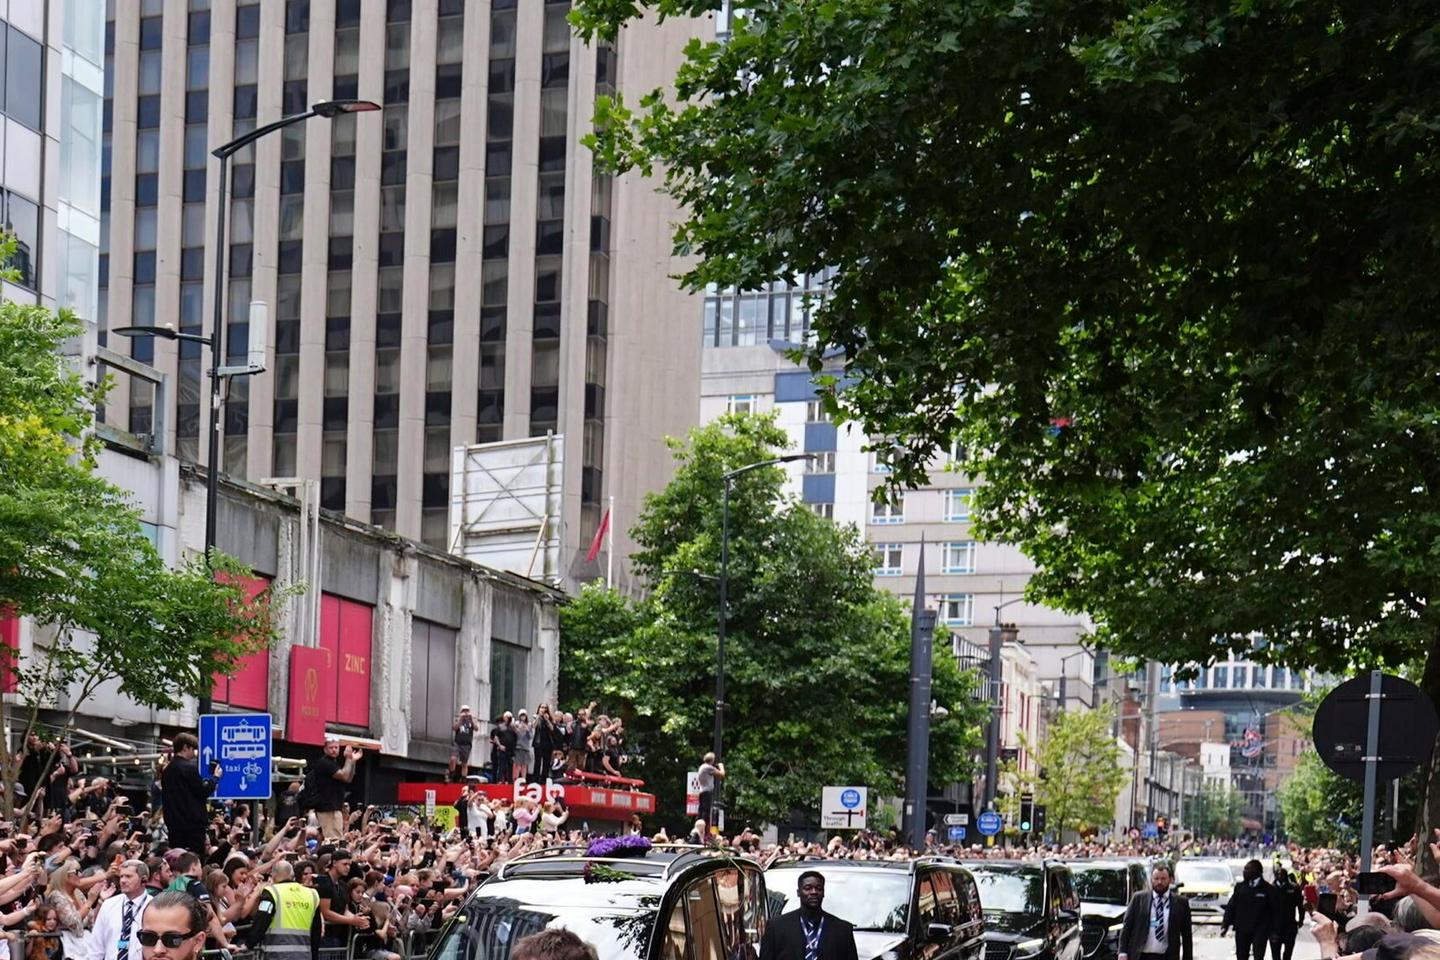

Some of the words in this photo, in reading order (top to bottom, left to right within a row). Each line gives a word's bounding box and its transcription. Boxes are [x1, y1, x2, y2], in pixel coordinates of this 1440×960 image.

[345, 653, 366, 675] ZINC
[225, 764, 241, 773] taxi
[513, 777, 565, 804] fab
